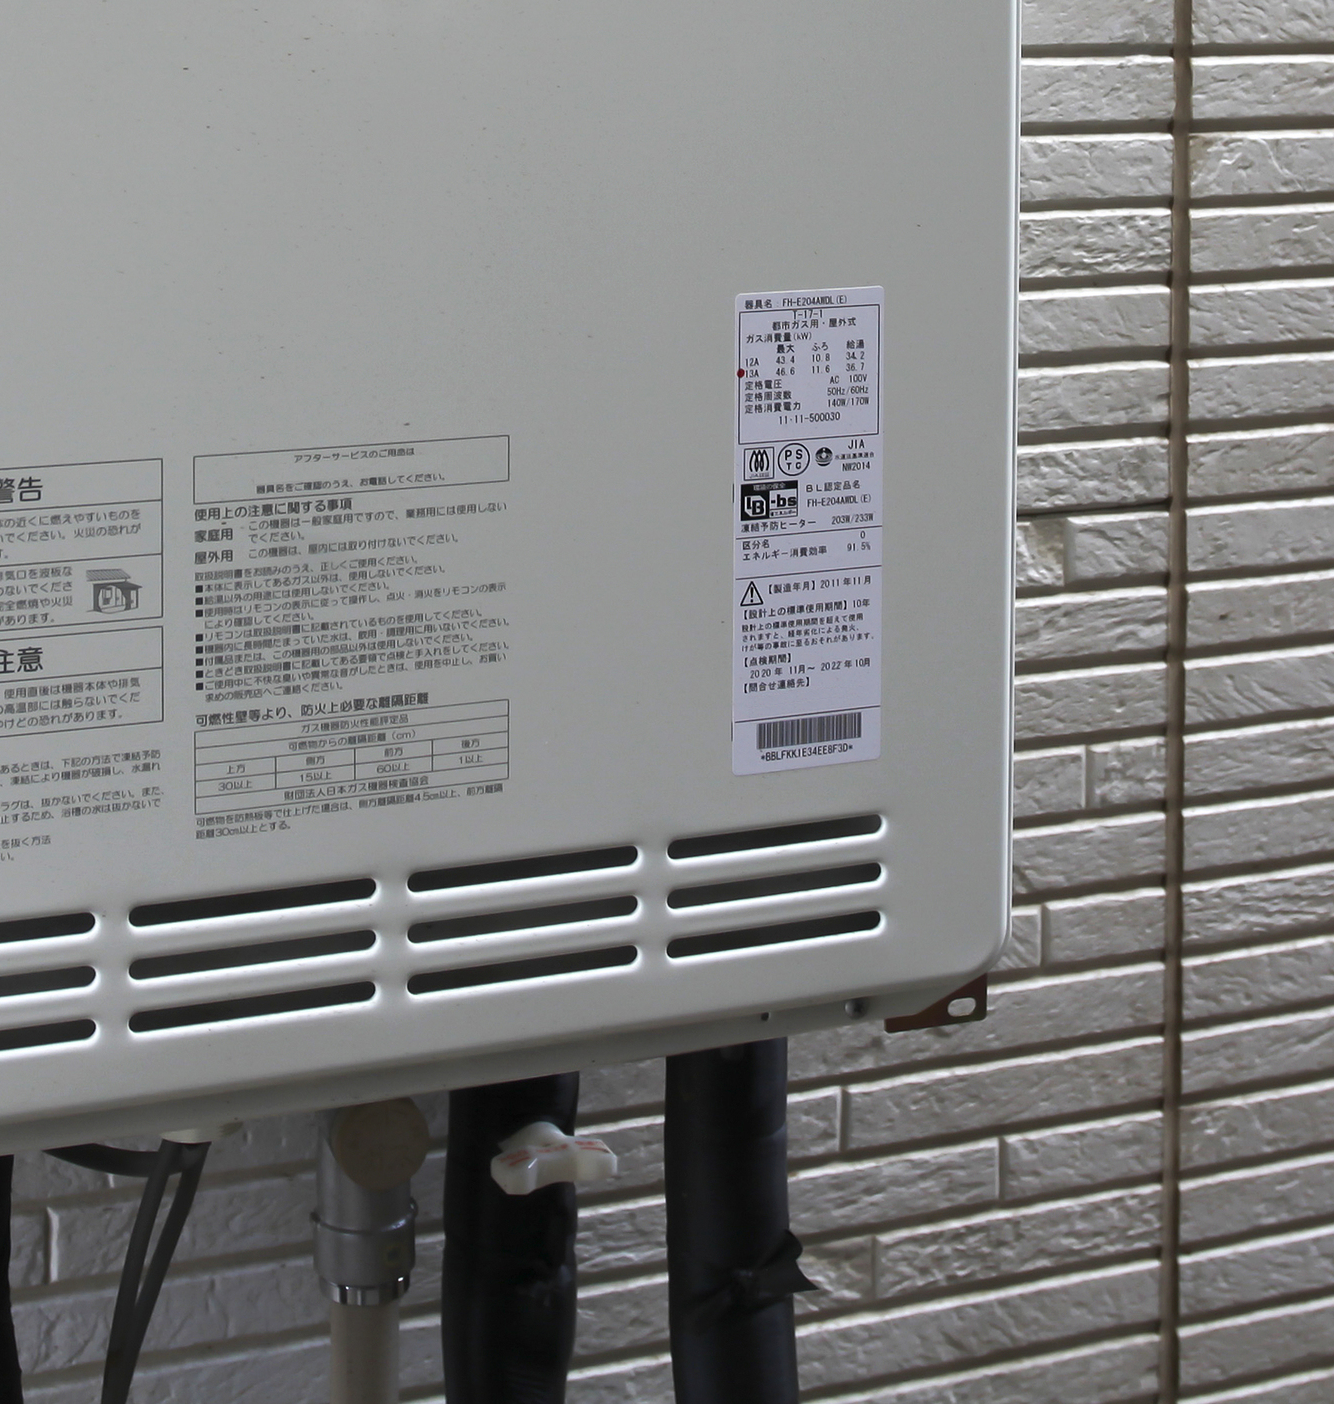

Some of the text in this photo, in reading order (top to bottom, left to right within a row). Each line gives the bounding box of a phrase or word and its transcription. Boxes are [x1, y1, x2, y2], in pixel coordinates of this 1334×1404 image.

[776, 344, 795, 354] 最大
[745, 357, 760, 367] 12A
[744, 379, 783, 391] 定格電圧
[849, 373, 868, 383] 100V
[744, 390, 793, 403] 定格周波数
[744, 401, 802, 414] 定格消費電力
[847, 439, 866, 450] JIA
[256, 473, 445, 494] 器具名をご確認のうえ、お電話してください。
[194, 497, 353, 521] 使用上の注意に関する事項
[248, 502, 507, 532] この機器は一般家庭用ですので、業務用には使用しない
[741, 518, 817, 533] 凍結予防ヒーター
[194, 528, 233, 543] 家庭用
[248, 532, 305, 544] でください。
[248, 534, 459, 559] この機器は、屋内には取り付けないでください。
[742, 539, 770, 550] 区分名
[194, 550, 234, 565] 屋外用
[742, 545, 827, 561] エネルギー消費効率
[194, 555, 417, 581] 取扱説明書をお読みのうえ、正しくご使用ください。
[204, 613, 315, 630] により確認してください。
[195, 691, 429, 727] 可燃性壁等より、防火上必要な離隔距離
[226, 738, 480, 775] 上方 側方 前方 後方
[218, 754, 484, 791] 30以上 15以上 60以上 1以上
